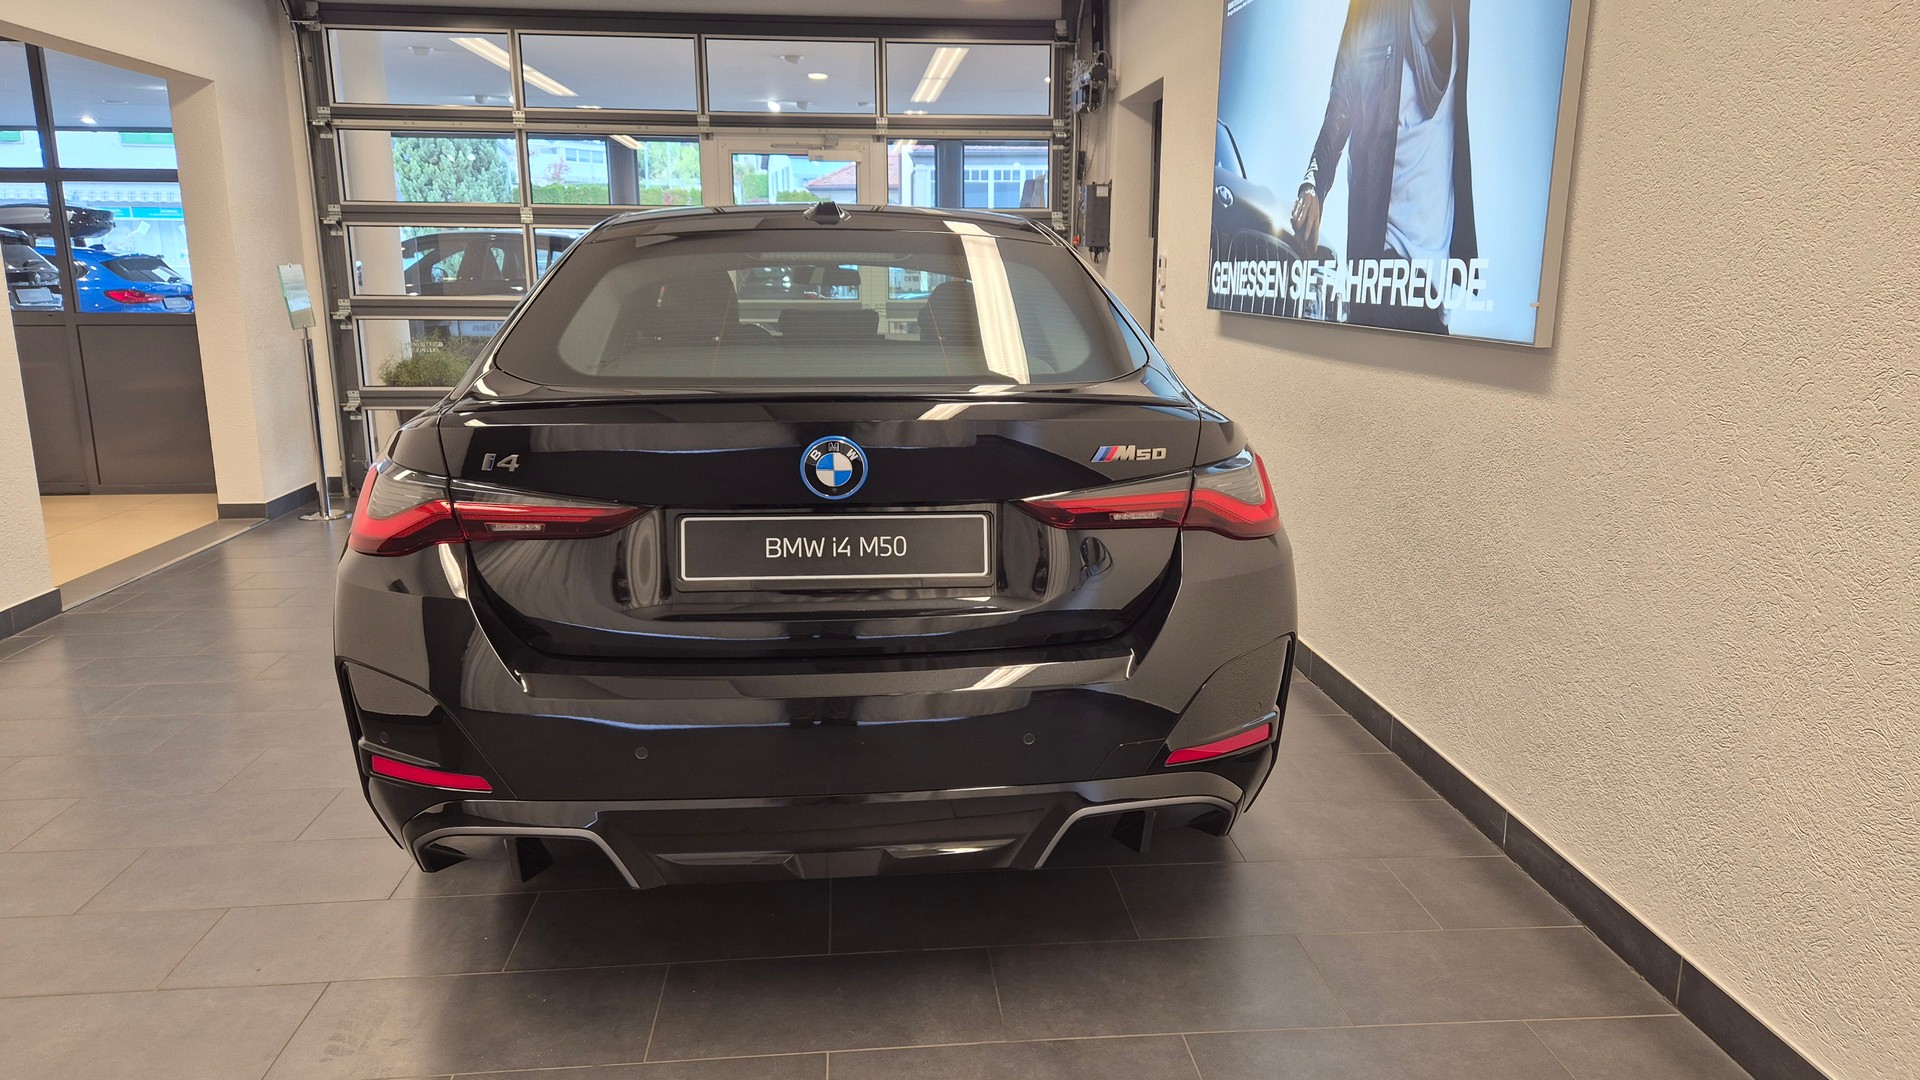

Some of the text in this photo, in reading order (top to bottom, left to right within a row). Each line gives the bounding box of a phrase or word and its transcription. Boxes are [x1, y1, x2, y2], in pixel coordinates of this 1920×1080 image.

[1211, 257, 1494, 312] GENIESSEN SIE FAHRFREUDE.
[809, 442, 859, 461] BMW
[1110, 444, 1167, 461] M50
[481, 452, 520, 472] i4
[765, 535, 908, 558] BMW i4 M50
